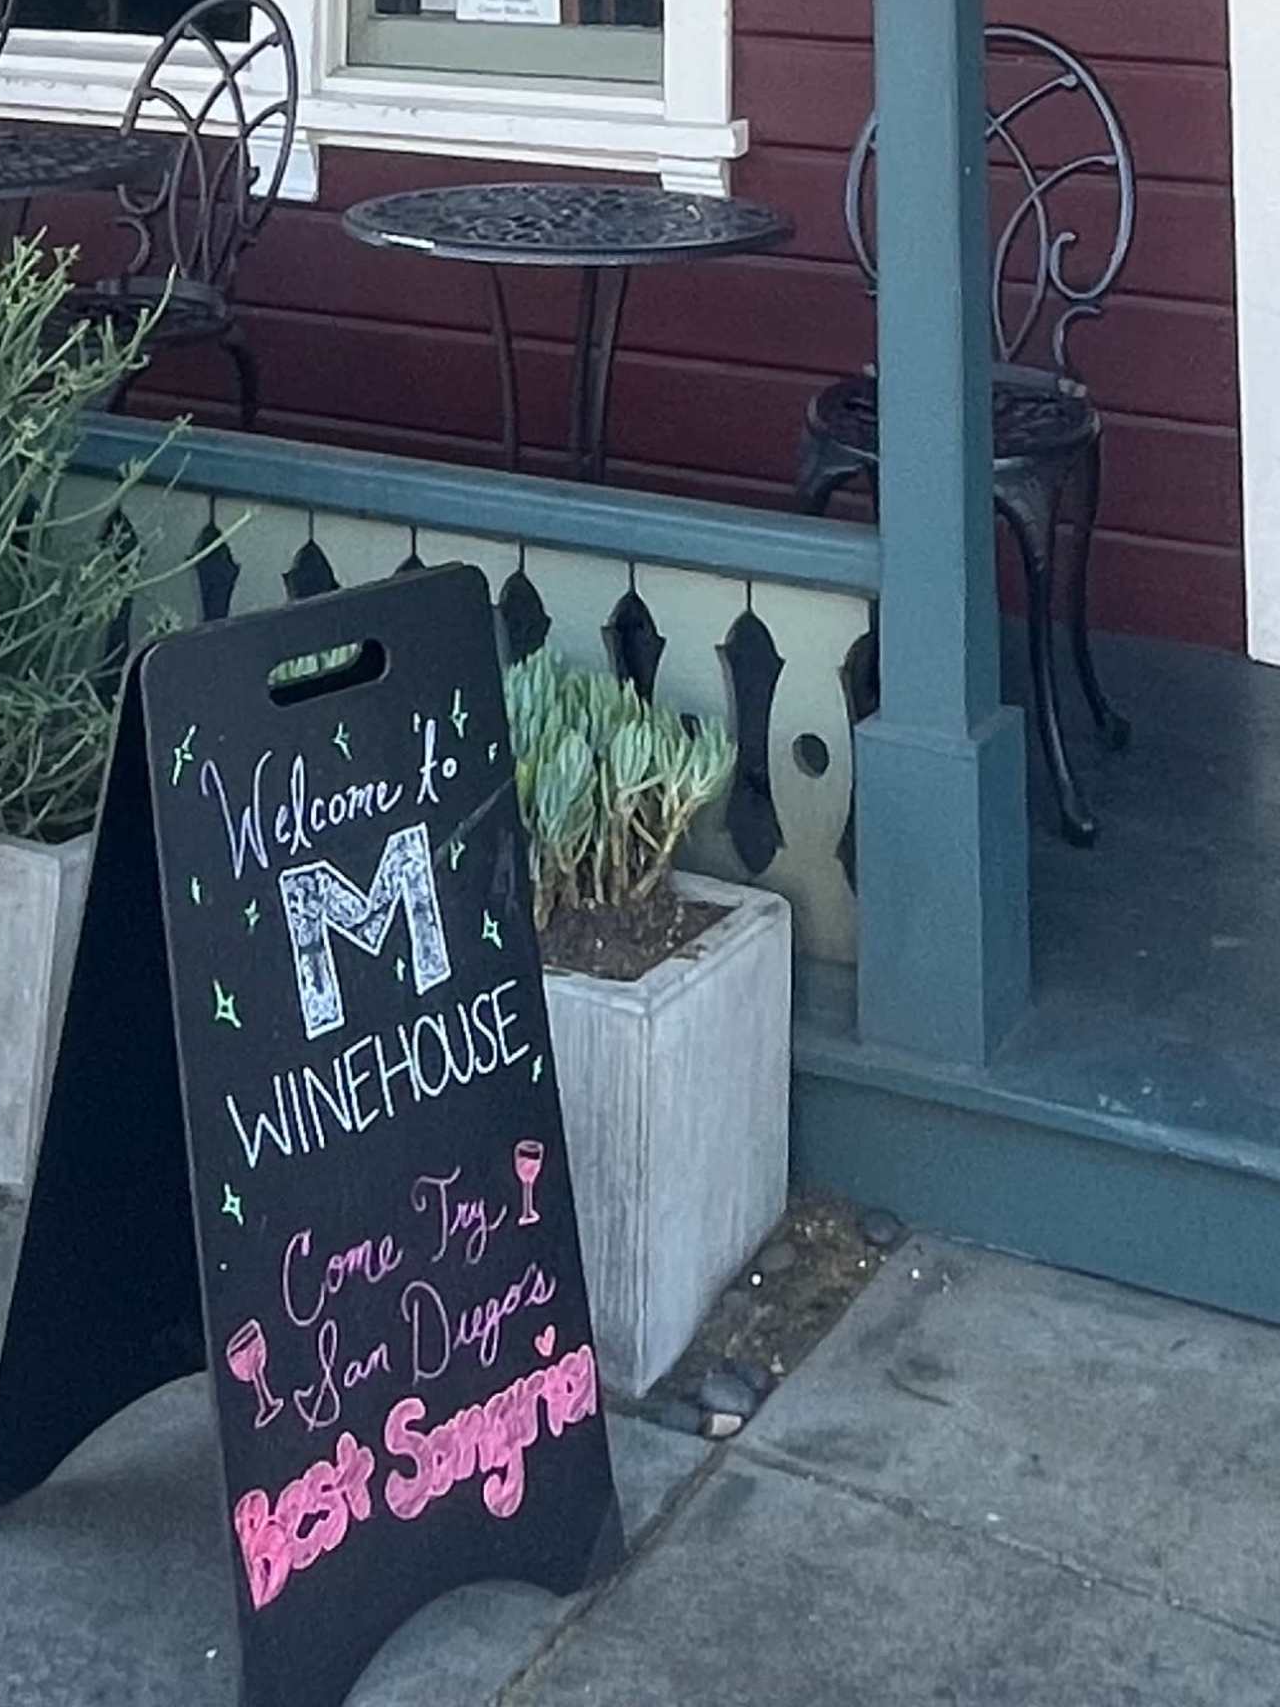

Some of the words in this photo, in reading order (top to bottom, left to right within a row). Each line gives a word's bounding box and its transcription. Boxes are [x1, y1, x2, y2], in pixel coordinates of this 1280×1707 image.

[201, 750, 403, 881] Welcome
[416, 718, 459, 805] to
[278, 822, 452, 1041] M
[226, 980, 531, 1170] WINEHOUSE
[282, 1227, 404, 1326] Come
[410, 1165, 508, 1265] Try
[292, 1318, 393, 1432] San
[234, 1431, 376, 1612] Best
[384, 1327, 598, 1519] Sangria
